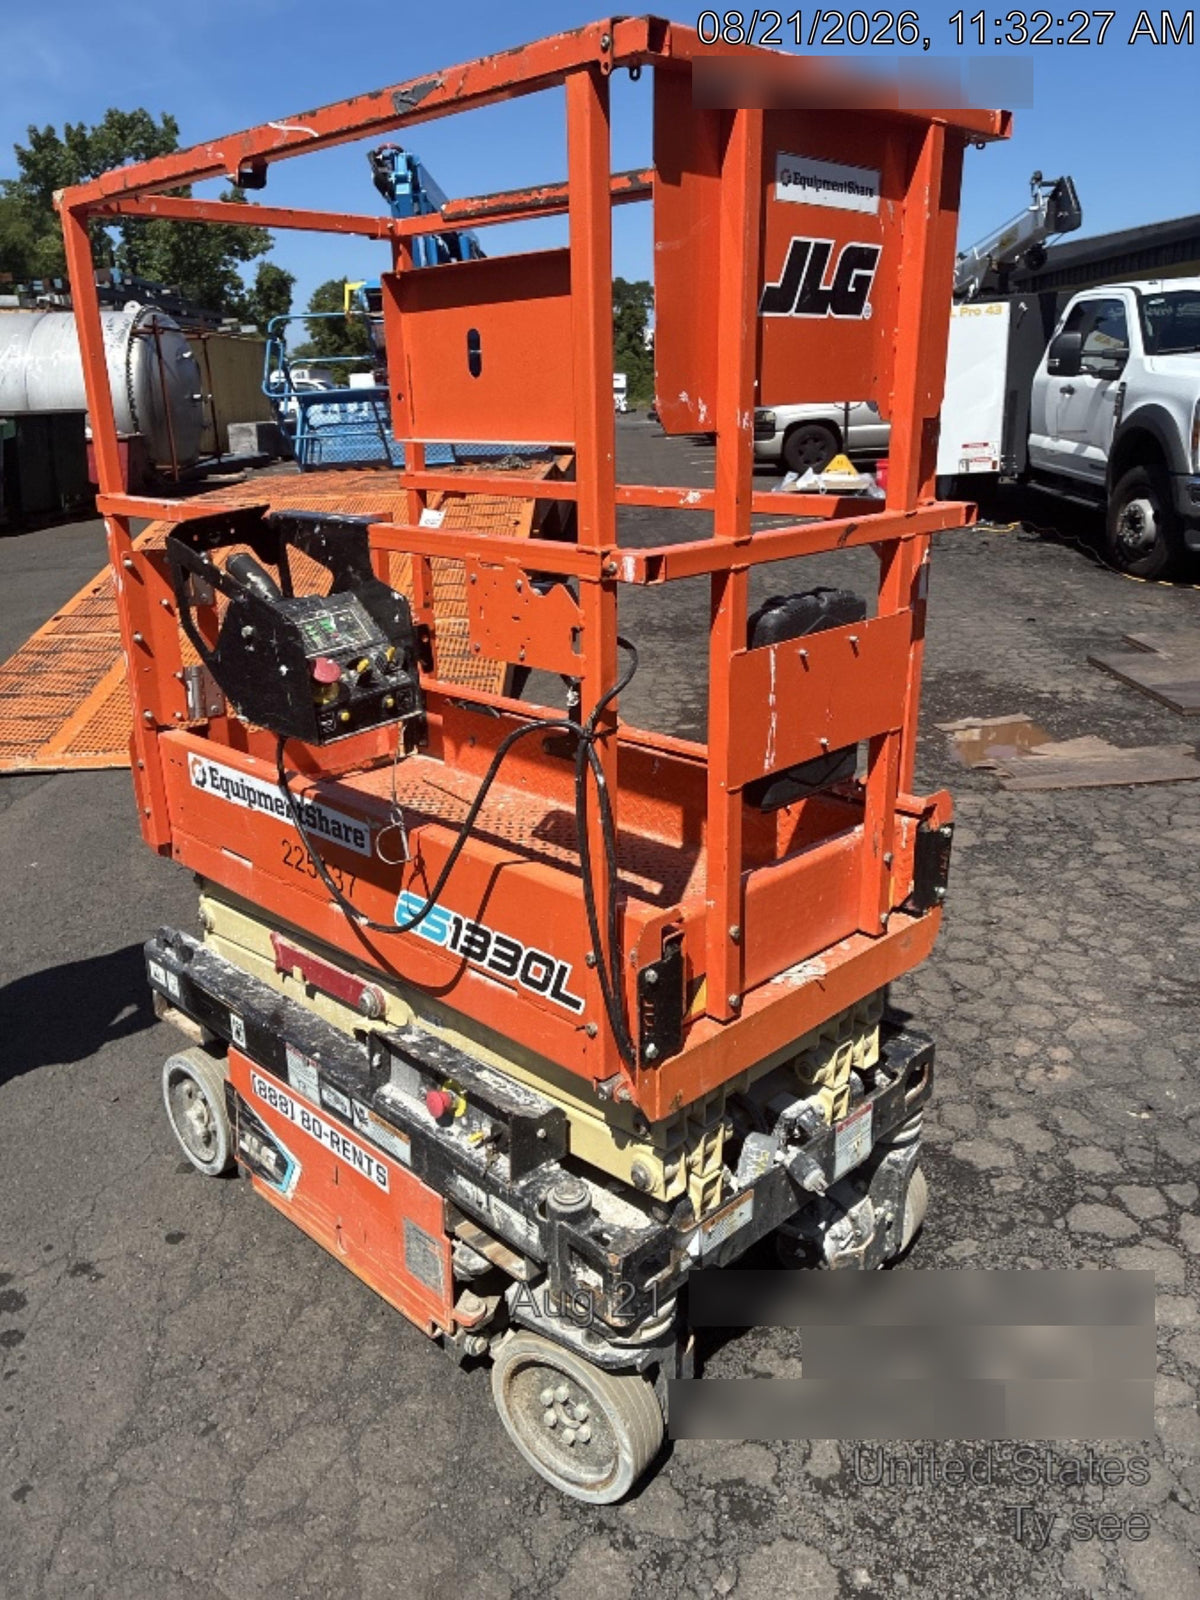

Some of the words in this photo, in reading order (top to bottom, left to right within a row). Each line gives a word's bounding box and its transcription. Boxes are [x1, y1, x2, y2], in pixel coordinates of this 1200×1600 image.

[792, 170, 875, 198] EquipmentShare
[759, 237, 883, 319] JLG
[281, 838, 357, 898] 22537
[301, 1110, 387, 1187] 80-RENTS
